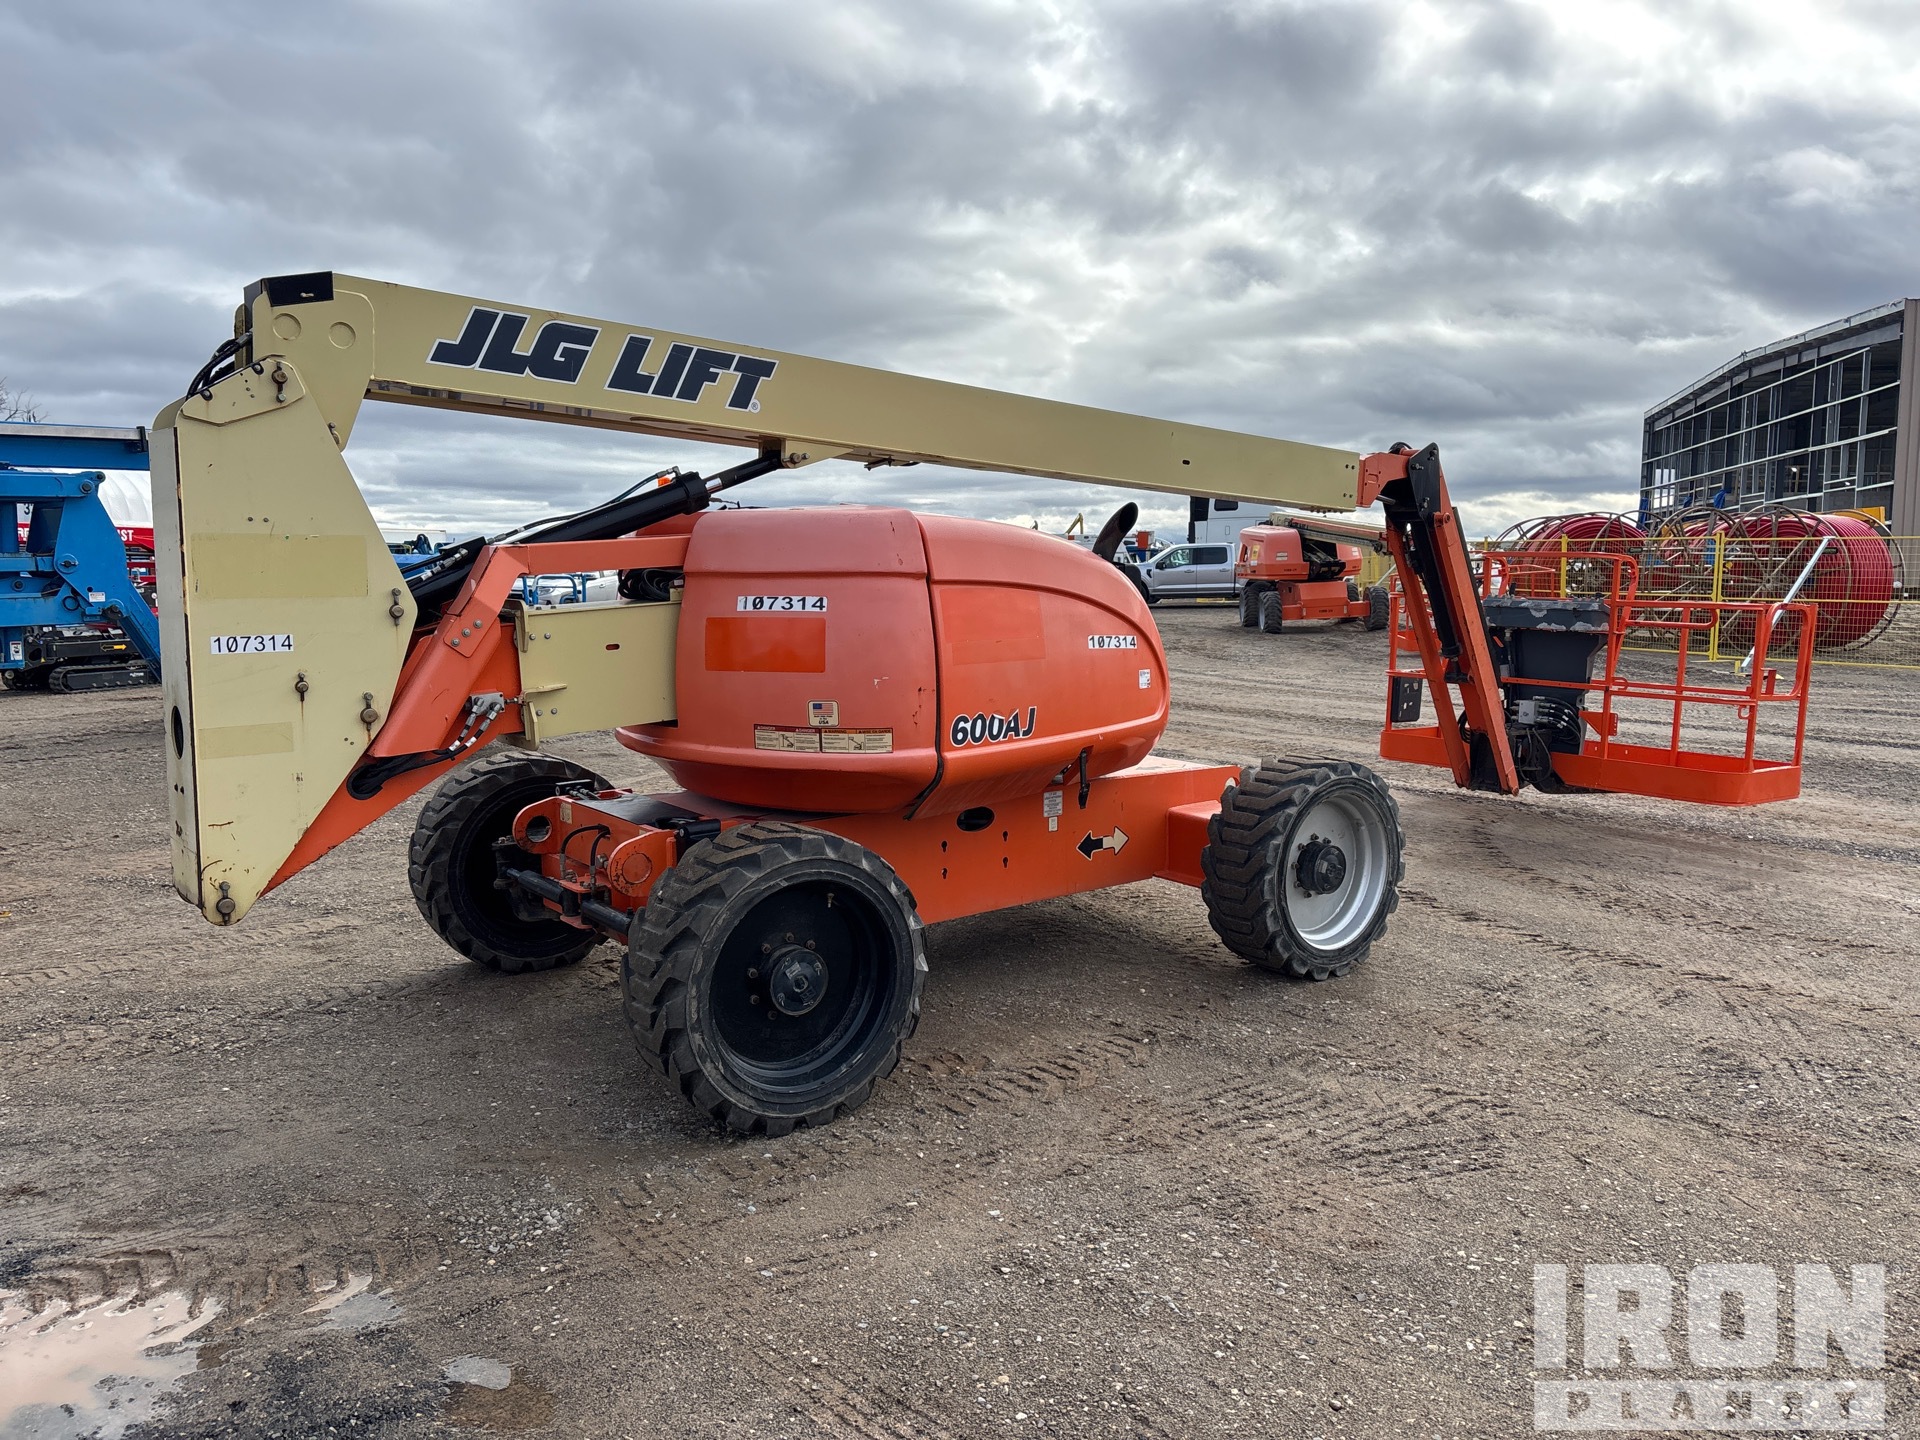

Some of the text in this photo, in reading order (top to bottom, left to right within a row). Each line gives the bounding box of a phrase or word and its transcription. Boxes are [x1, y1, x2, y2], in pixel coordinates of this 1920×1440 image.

[426, 306, 602, 385] JLG
[738, 596, 827, 611] 107314
[213, 634, 293, 653] 107314
[1088, 635, 1137, 648] 107314
[950, 706, 1037, 747] 600AJ
